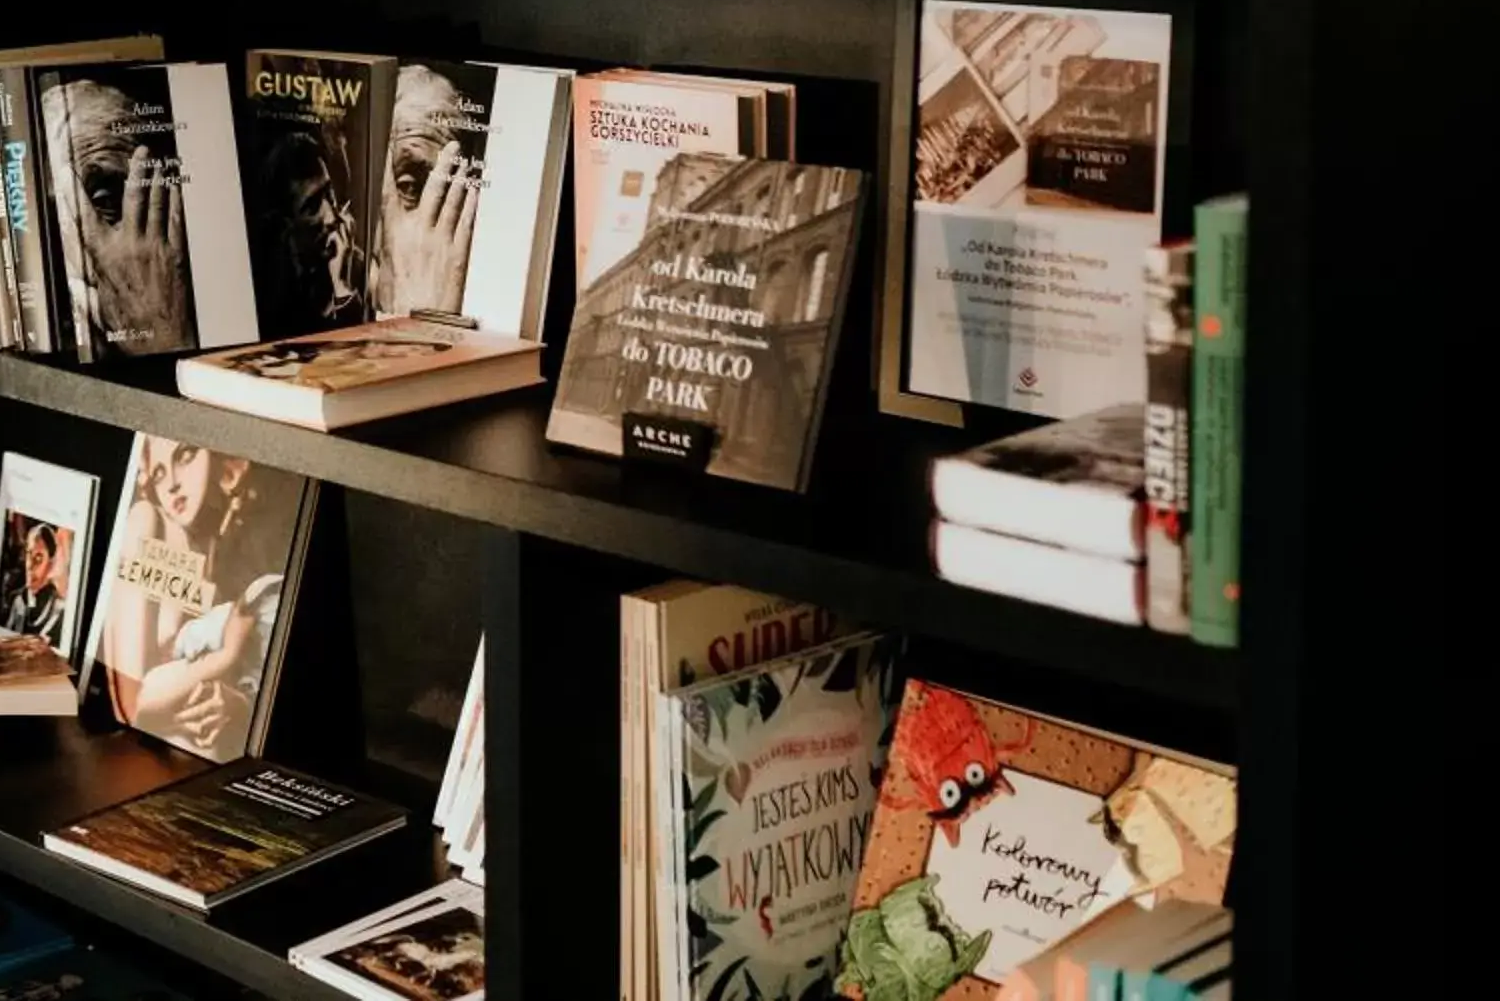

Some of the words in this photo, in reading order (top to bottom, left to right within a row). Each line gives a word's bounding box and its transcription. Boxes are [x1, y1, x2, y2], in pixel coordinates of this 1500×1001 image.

[254, 71, 363, 107] GUSTAW
[453, 96, 485, 114] Adam
[132, 103, 165, 117] Adam
[590, 110, 637, 128] SZTUKA
[641, 117, 711, 137] KOCHANIA
[590, 124, 680, 148] GORSZYCIELKI
[651, 254, 682, 278] od
[684, 256, 758, 291] Karola
[632, 283, 765, 328] Kretschmera
[622, 336, 649, 362] do
[655, 341, 753, 382] TOBACO
[645, 376, 715, 413] PARK
[632, 425, 692, 448] ARCHE
[980, 823, 1111, 908] Kolorowy
[983, 872, 1076, 919] potwór
